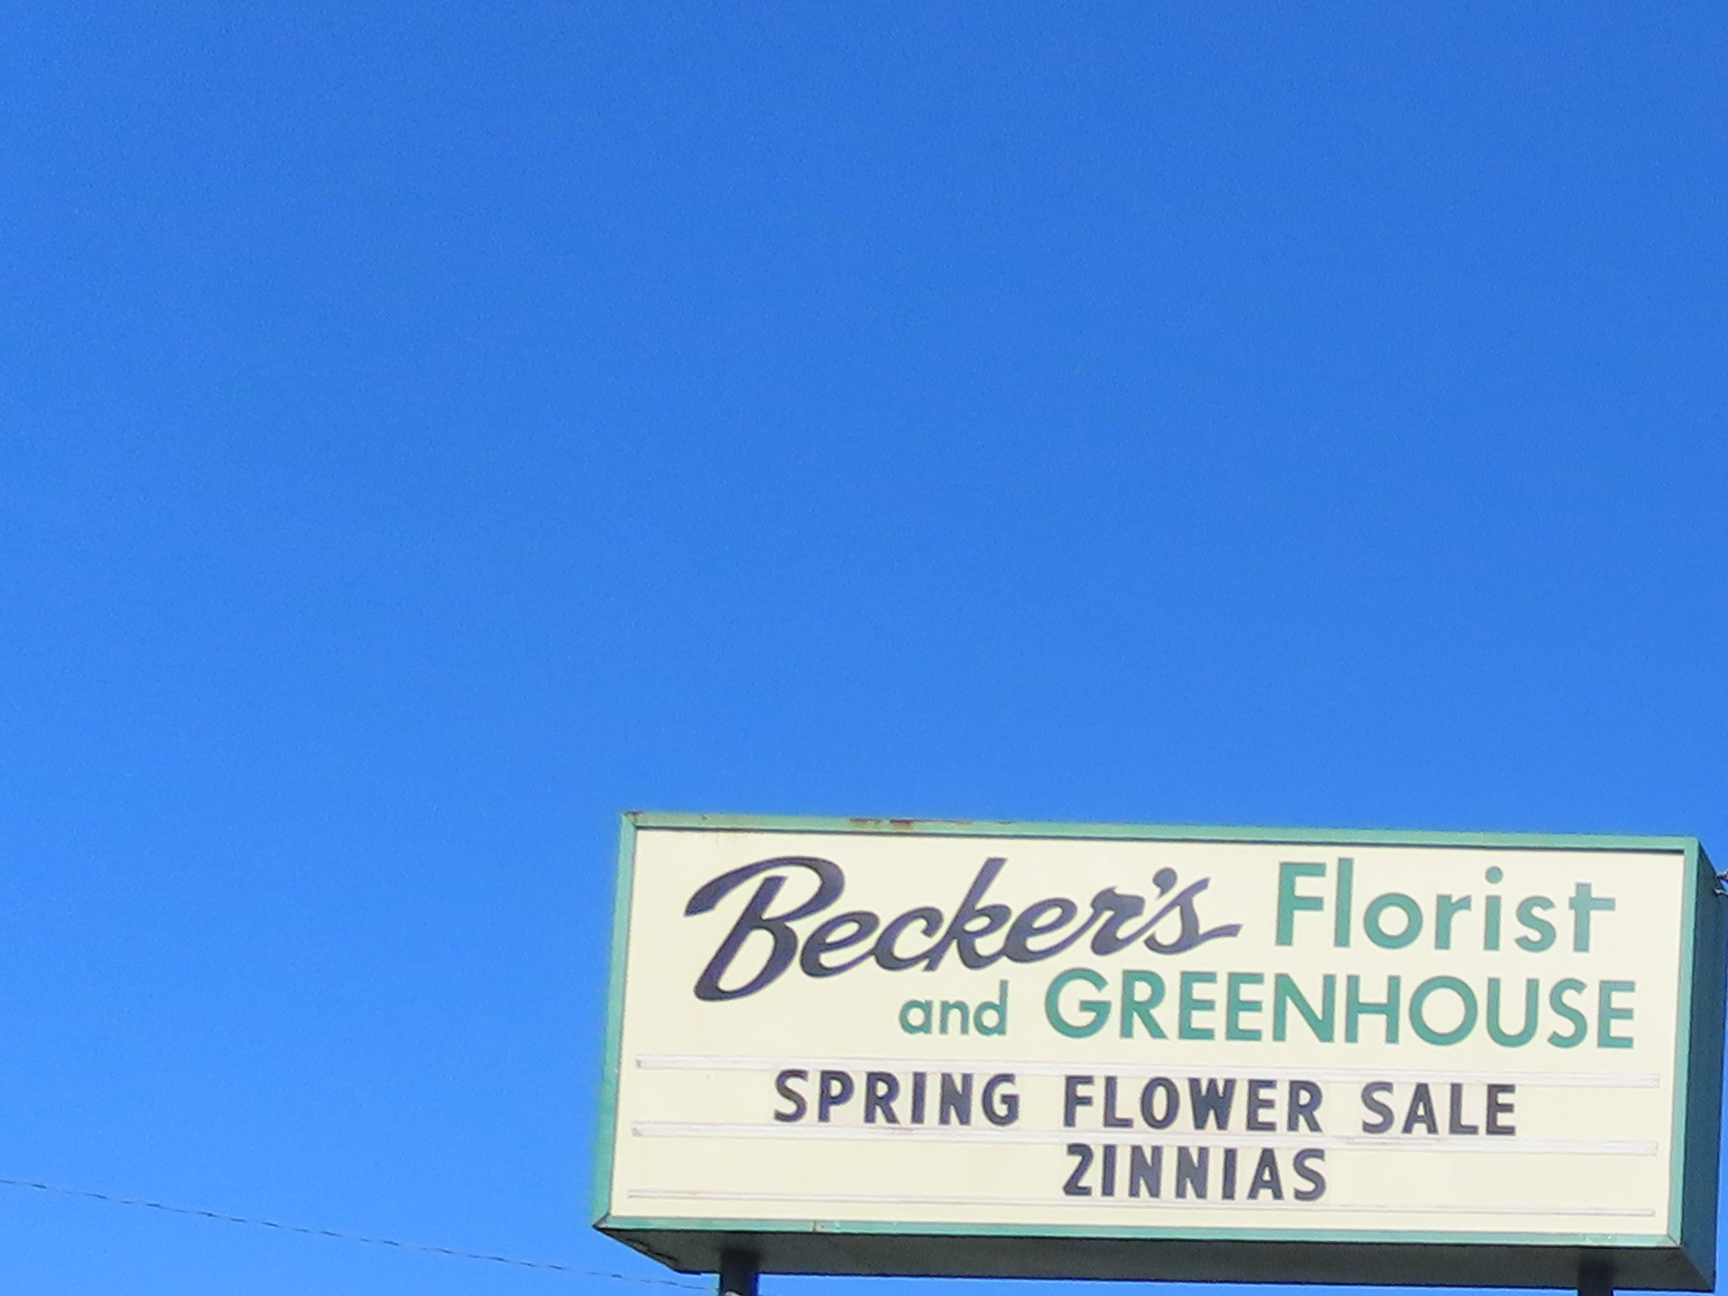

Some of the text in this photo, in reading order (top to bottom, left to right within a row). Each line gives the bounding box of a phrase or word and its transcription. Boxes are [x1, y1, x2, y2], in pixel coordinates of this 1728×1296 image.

[685, 856, 1615, 1002] Becker's Florist
[898, 967, 1636, 1049] and GREENHOUSE
[773, 1068, 1517, 1136] SPRING FLOWER SALE
